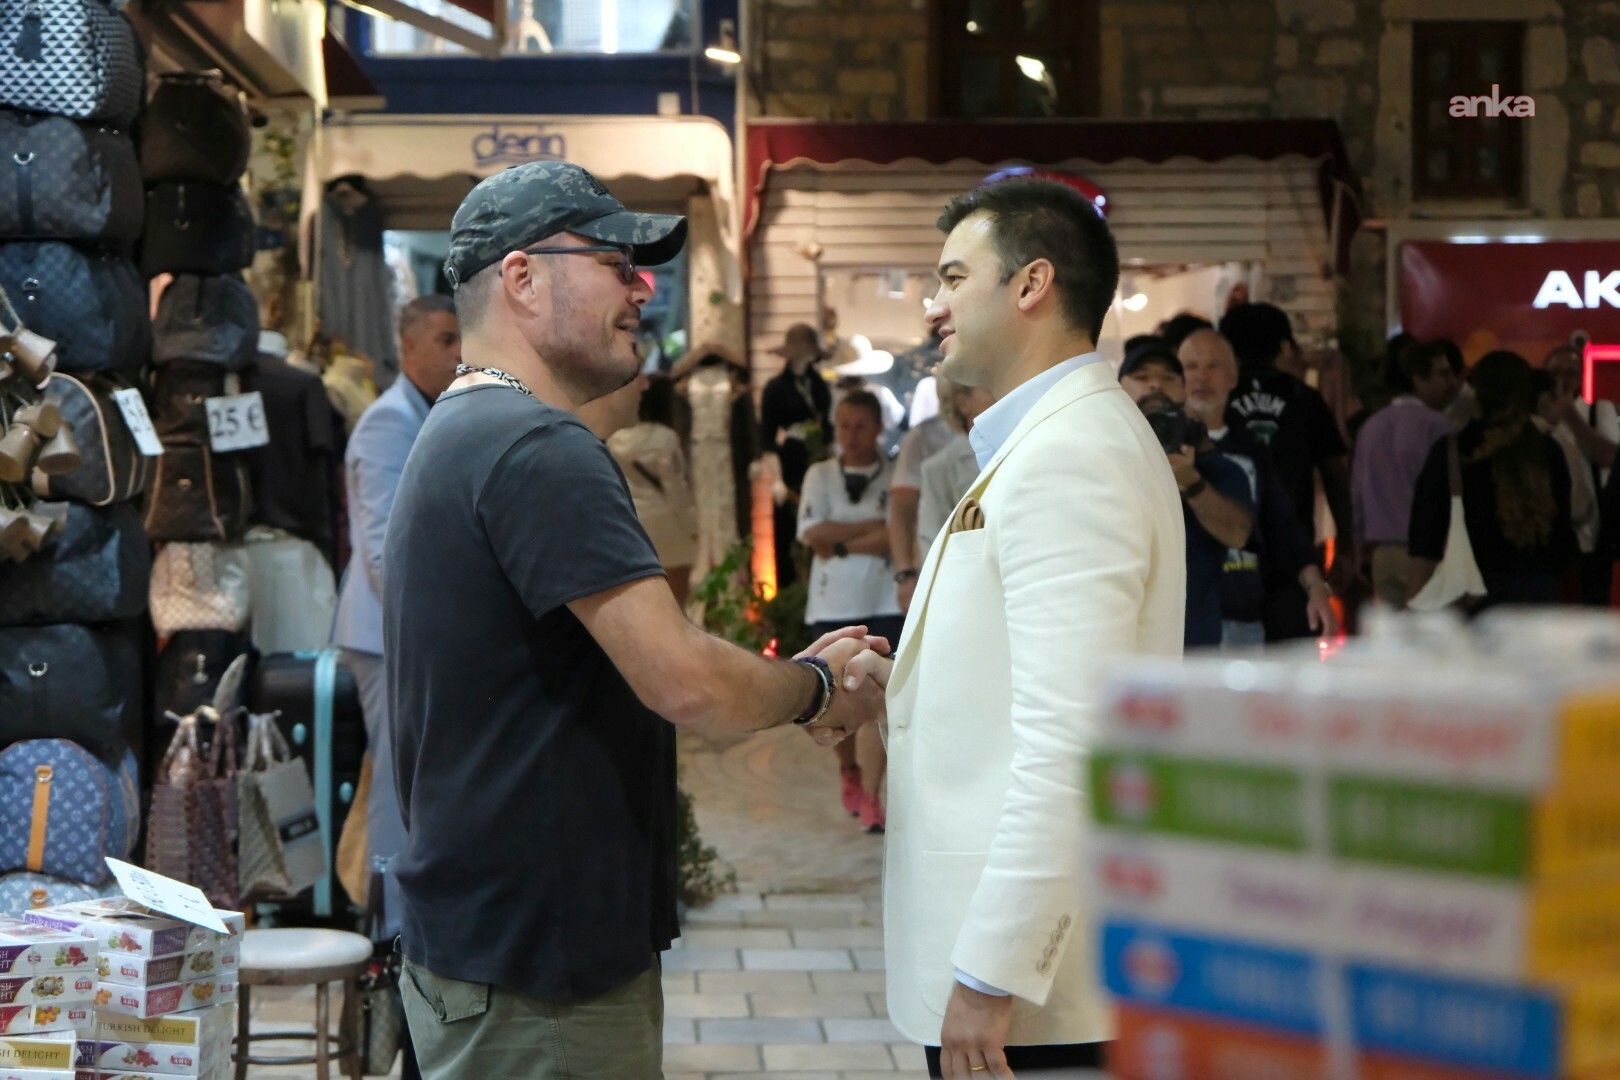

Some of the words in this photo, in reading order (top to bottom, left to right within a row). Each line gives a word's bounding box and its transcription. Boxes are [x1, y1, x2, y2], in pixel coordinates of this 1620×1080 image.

[98, 1021, 140, 1034] TURKISH
[143, 1025, 186, 1036] DELIGHT
[14, 1049, 60, 1060] DELIGHT
